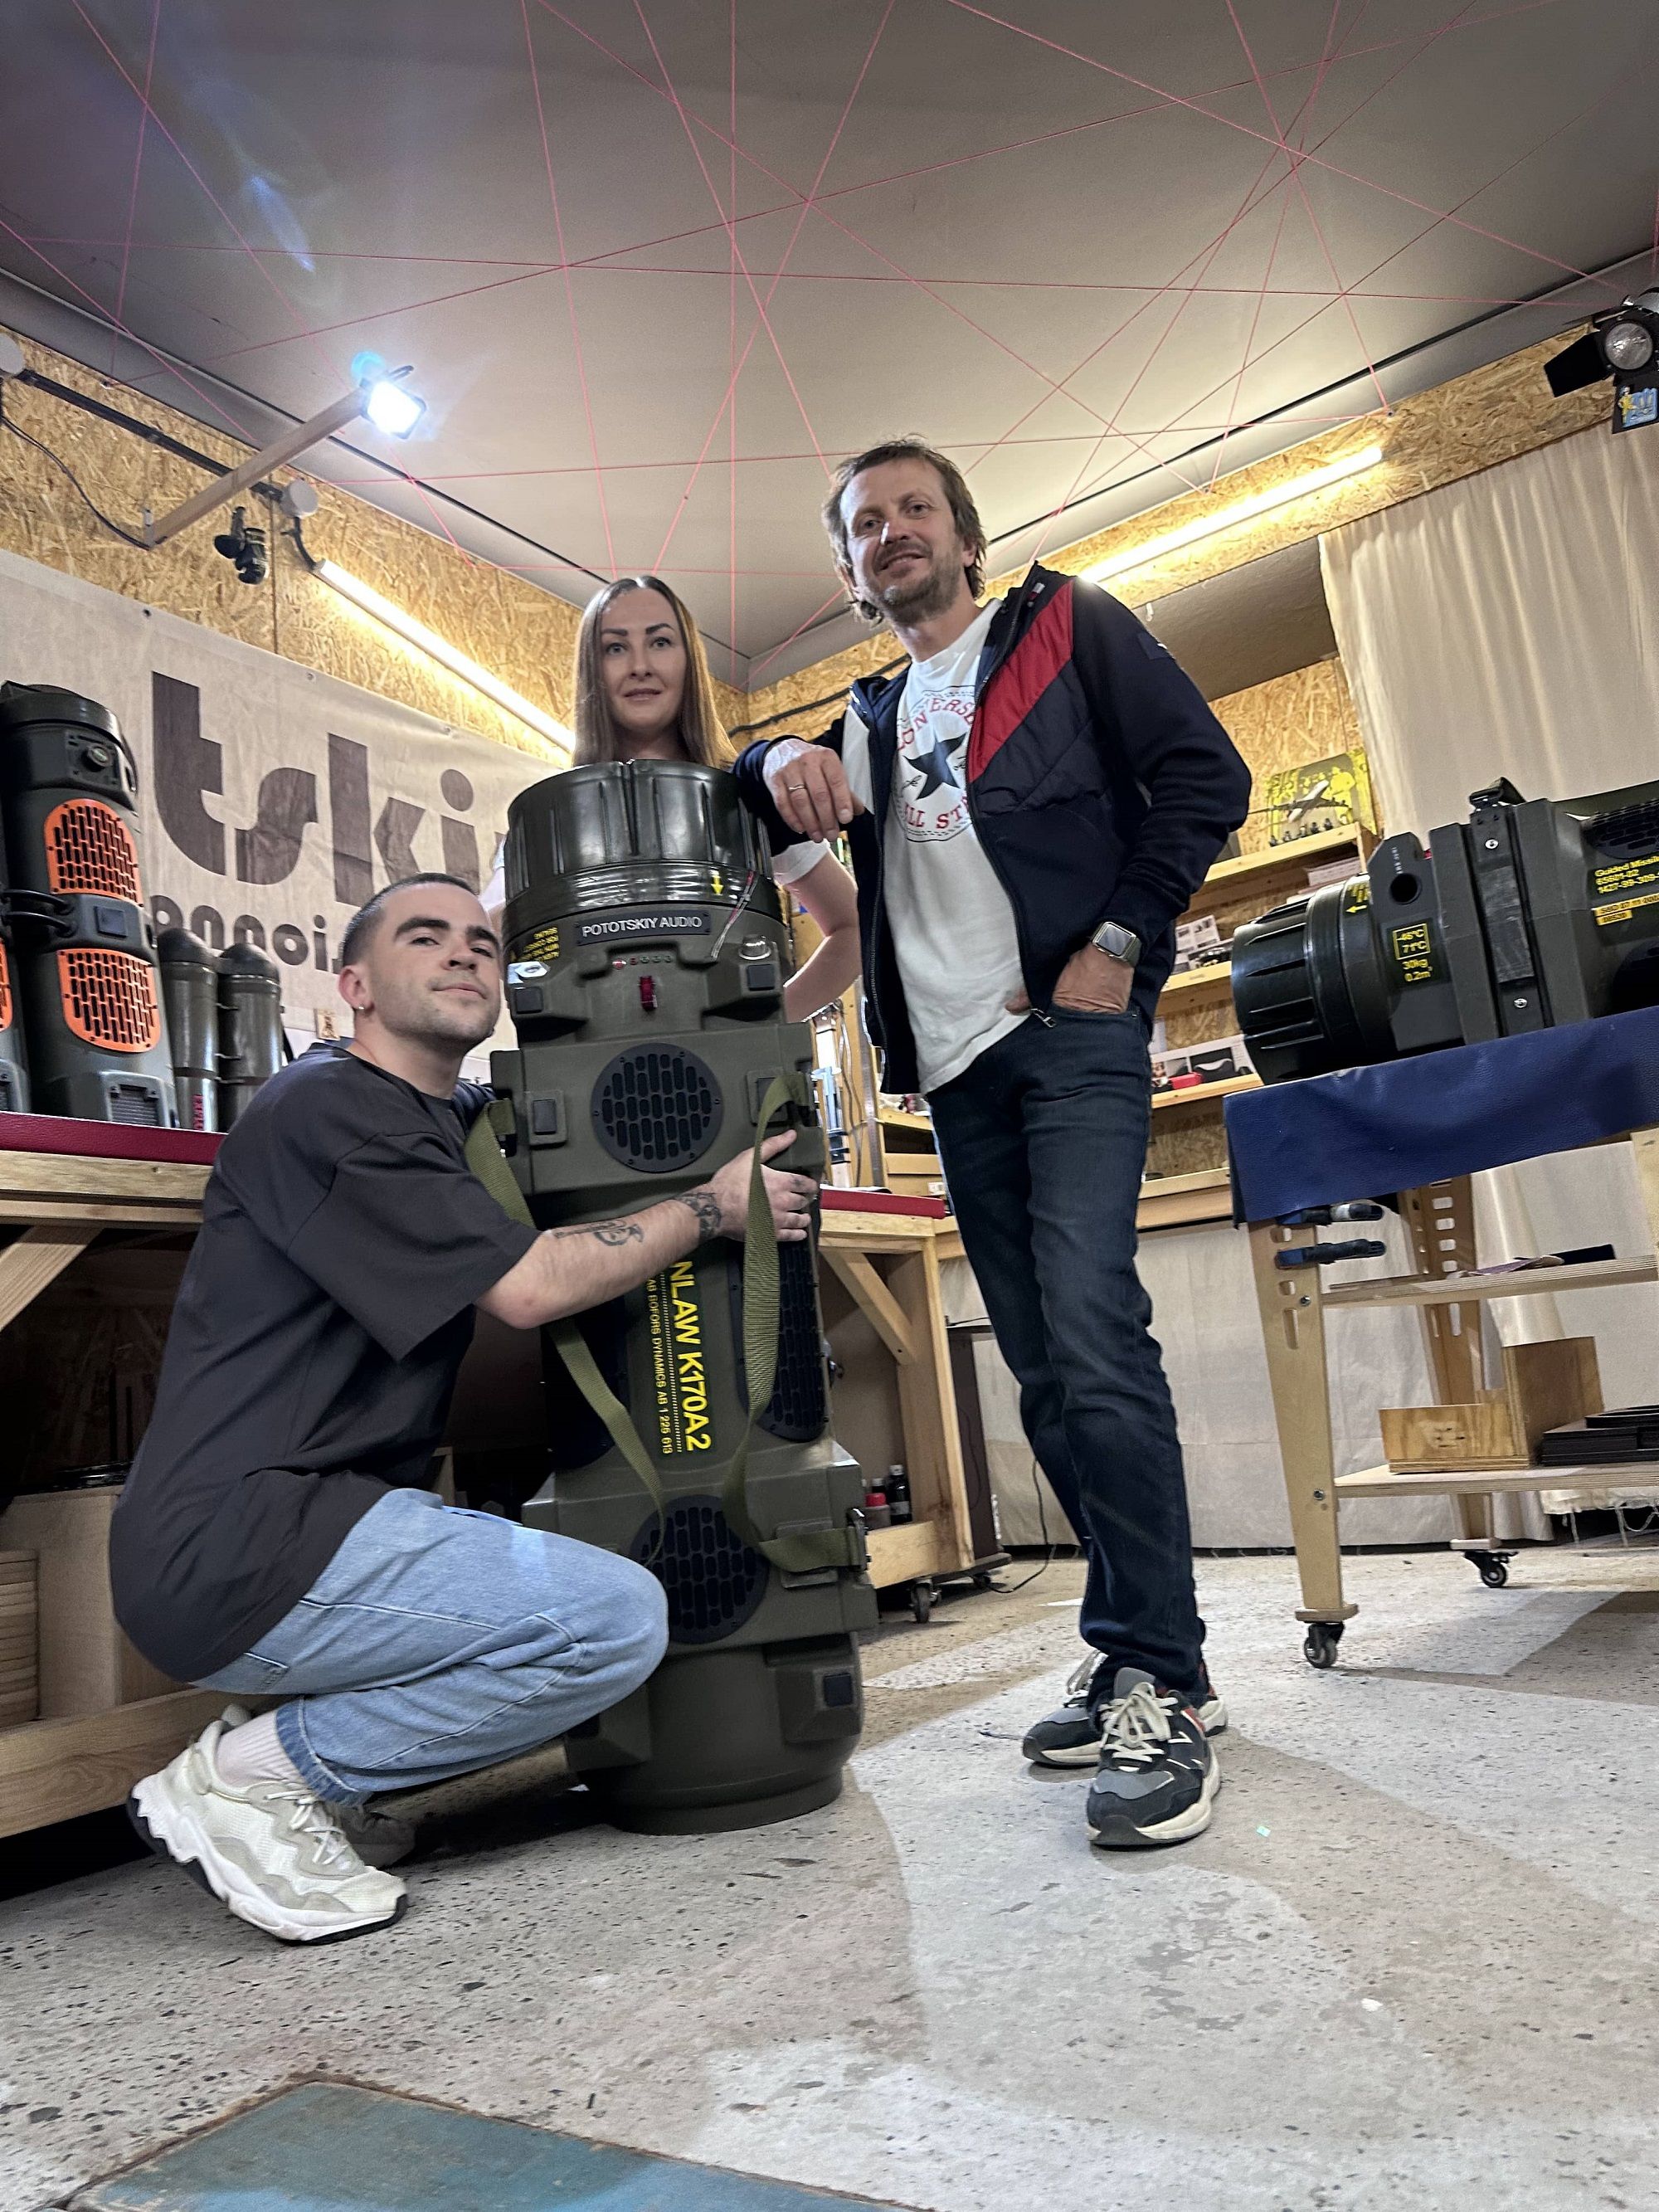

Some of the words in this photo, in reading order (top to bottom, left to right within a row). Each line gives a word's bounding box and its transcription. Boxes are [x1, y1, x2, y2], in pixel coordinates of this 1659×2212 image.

[897, 698, 975, 752] ONERSE
[152, 670, 504, 908] tski
[581, 917, 659, 938] POTOTSKIY
[659, 916, 703, 928] AUDIO
[648, 1294, 662, 1335] BOFORS
[669, 1261, 701, 1344] NLAW
[651, 1337, 667, 1388] DYNAMICS
[656, 1391, 669, 1405] AB
[677, 1352, 712, 1451] K170A2
